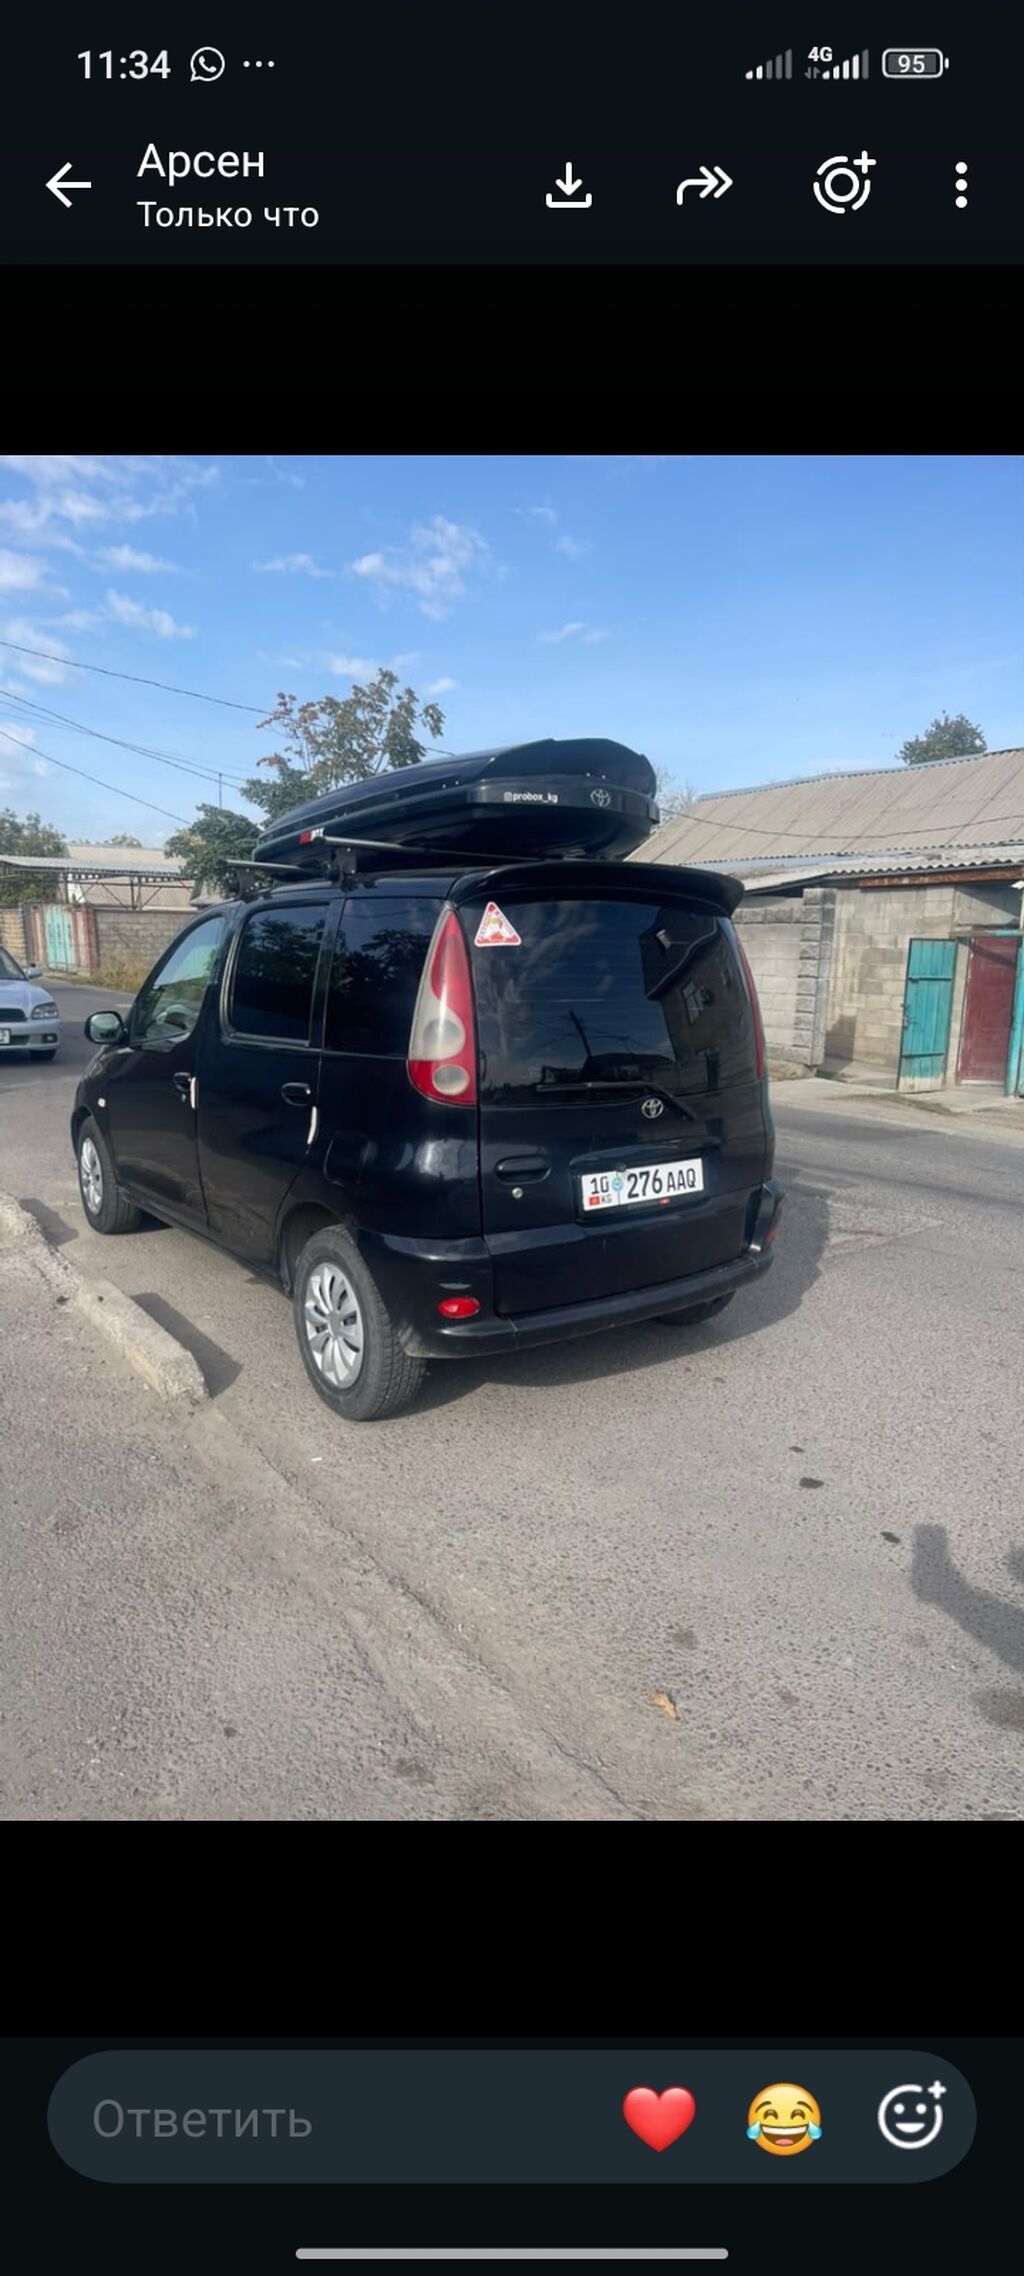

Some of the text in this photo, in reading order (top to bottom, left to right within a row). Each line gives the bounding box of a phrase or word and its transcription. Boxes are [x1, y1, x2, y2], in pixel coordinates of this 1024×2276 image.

[590, 1168, 696, 1199] 10 276 AAQ
